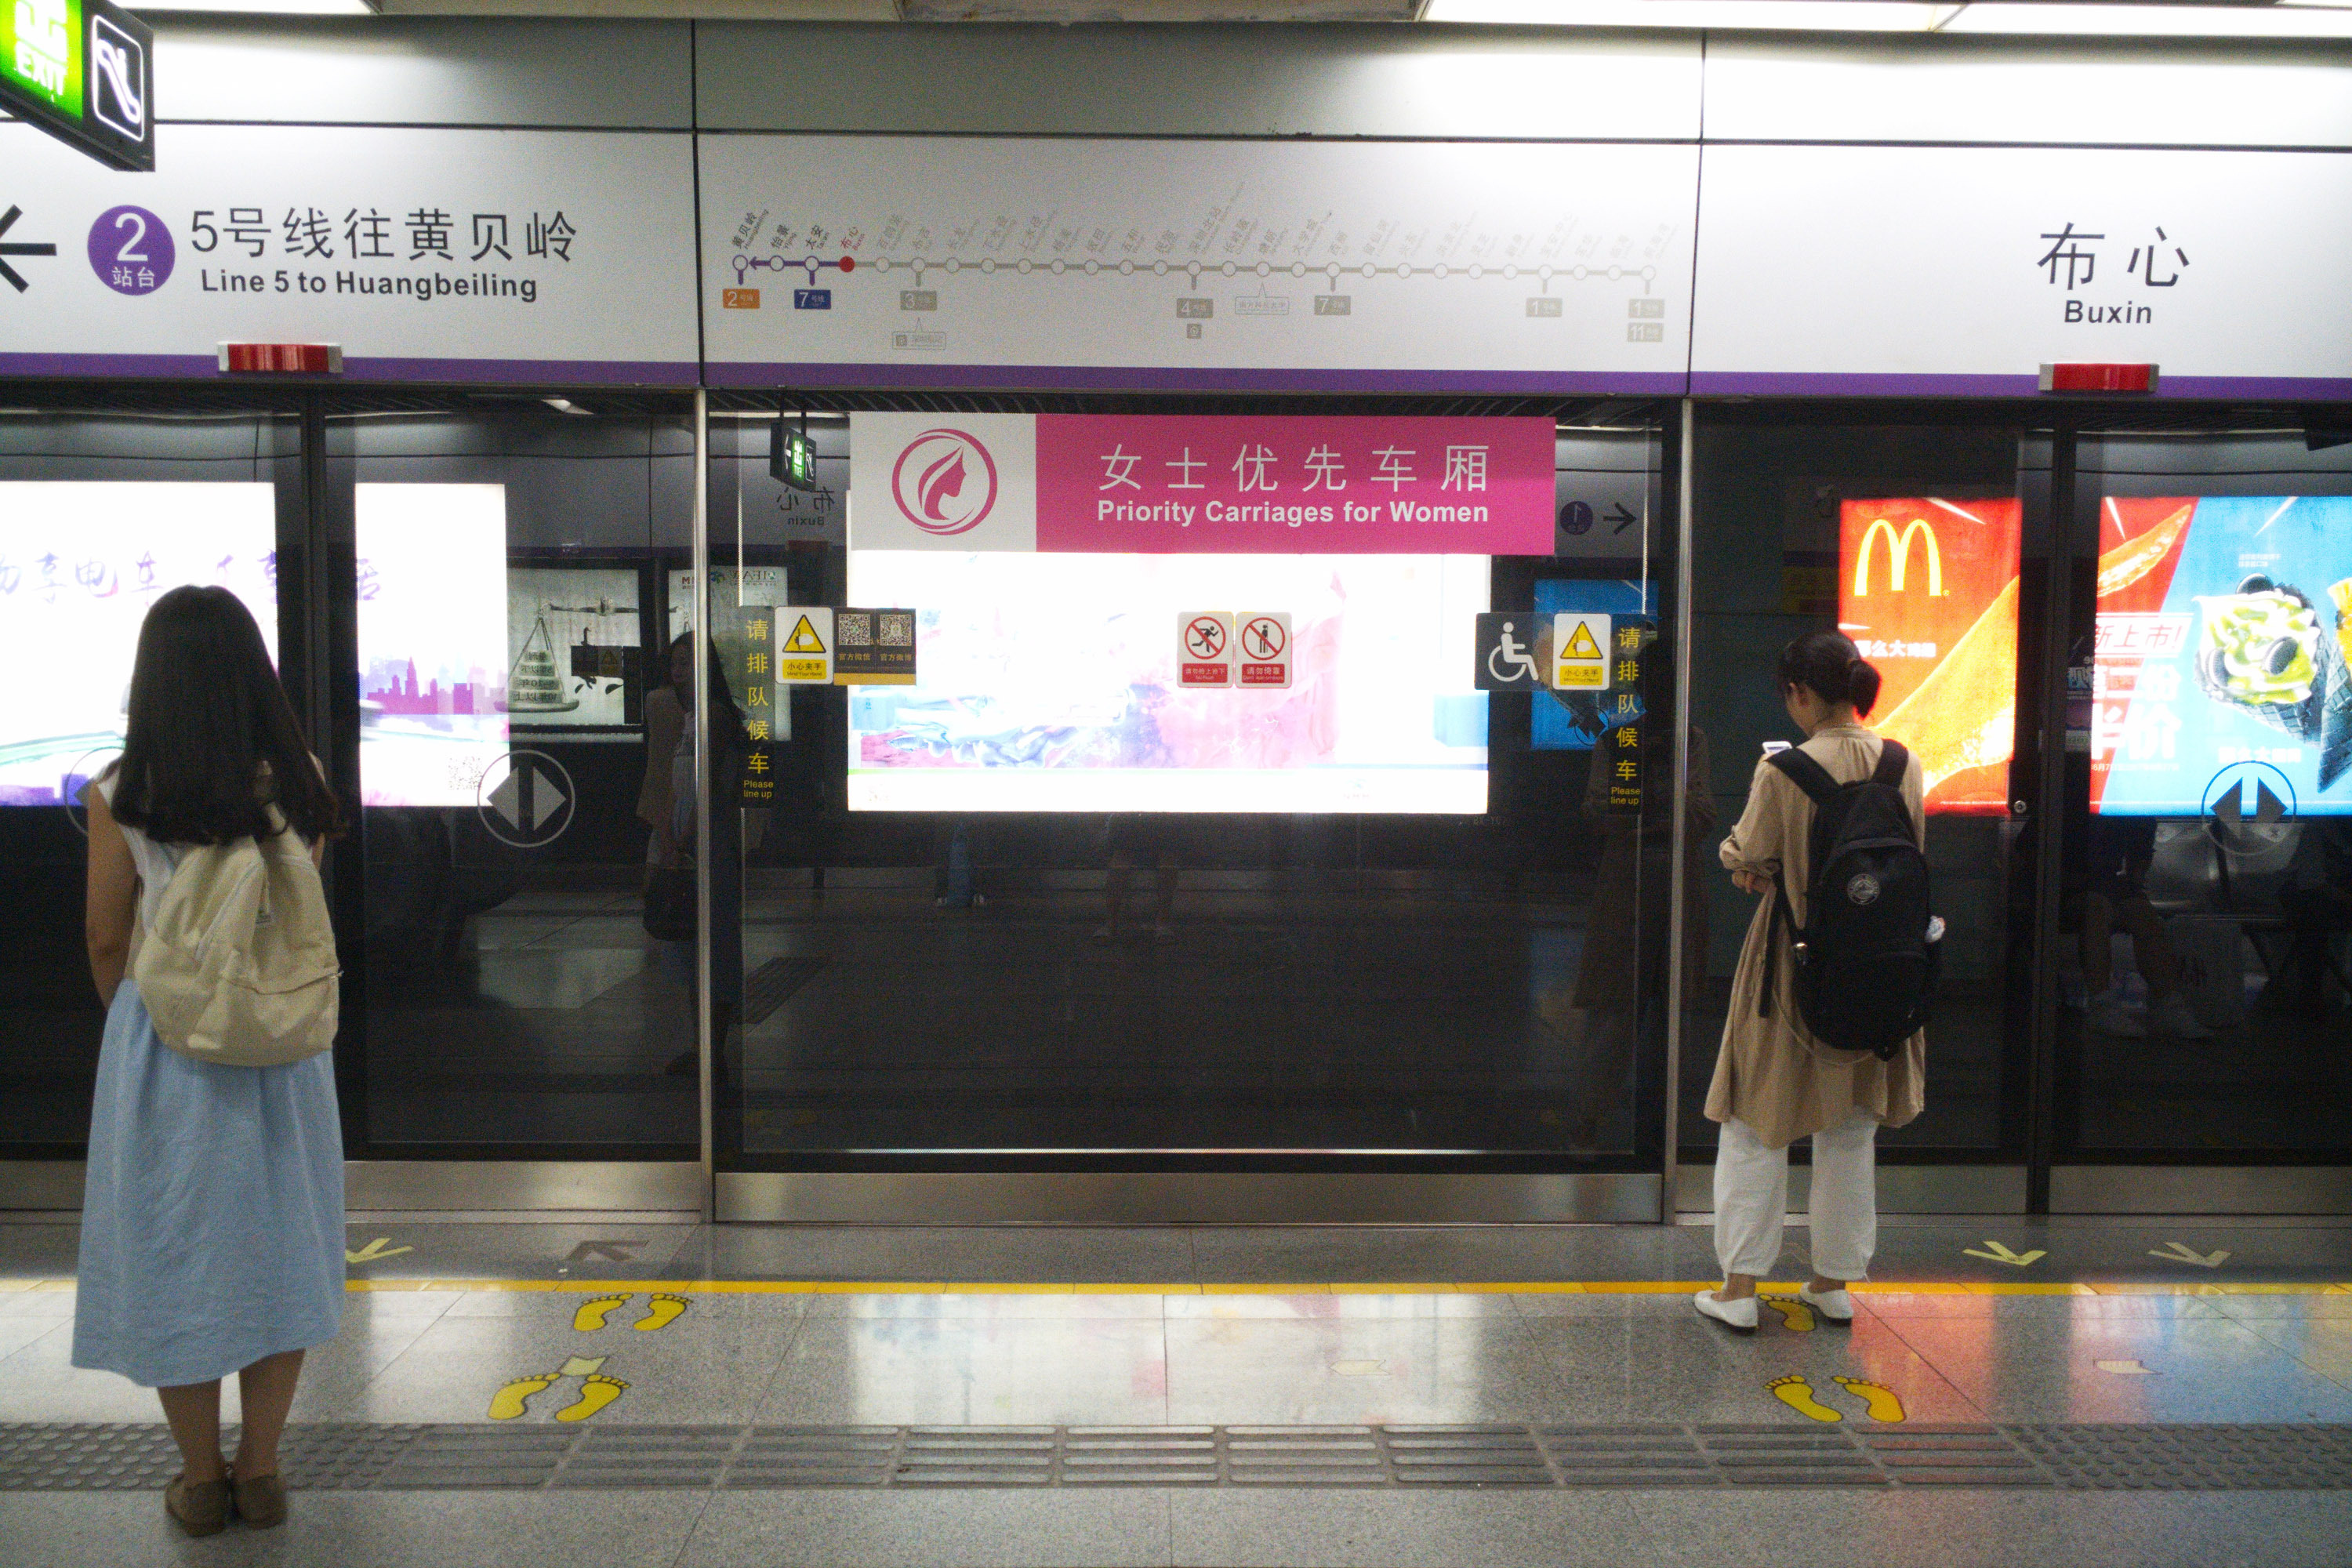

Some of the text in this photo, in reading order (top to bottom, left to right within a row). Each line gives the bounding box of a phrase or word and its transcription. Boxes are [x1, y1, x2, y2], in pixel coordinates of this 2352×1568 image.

[16, 40, 67, 96] EXIT
[115, 210, 151, 261] 2
[192, 209, 577, 263] 5号线往黄贝岭
[731, 212, 757, 248] 黄贝岭
[805, 223, 823, 249] 太安
[840, 226, 858, 249] 布心
[2038, 223, 2189, 290] 布心
[112, 267, 154, 287] 站台
[201, 270, 536, 303] Line 5 to Huangbeiling
[728, 291, 738, 307] 2
[799, 292, 808, 307] 7
[905, 293, 915, 309] 3
[1181, 301, 1190, 315] 4
[1320, 298, 1329, 313] 7
[2064, 300, 2151, 323] Buxin
[1099, 445, 1494, 494] 女士优先车厢
[1098, 500, 1488, 528] Priority Carriages for Women
[747, 619, 768, 773] 请排队候车
[1617, 628, 1640, 780] 请排队候车
